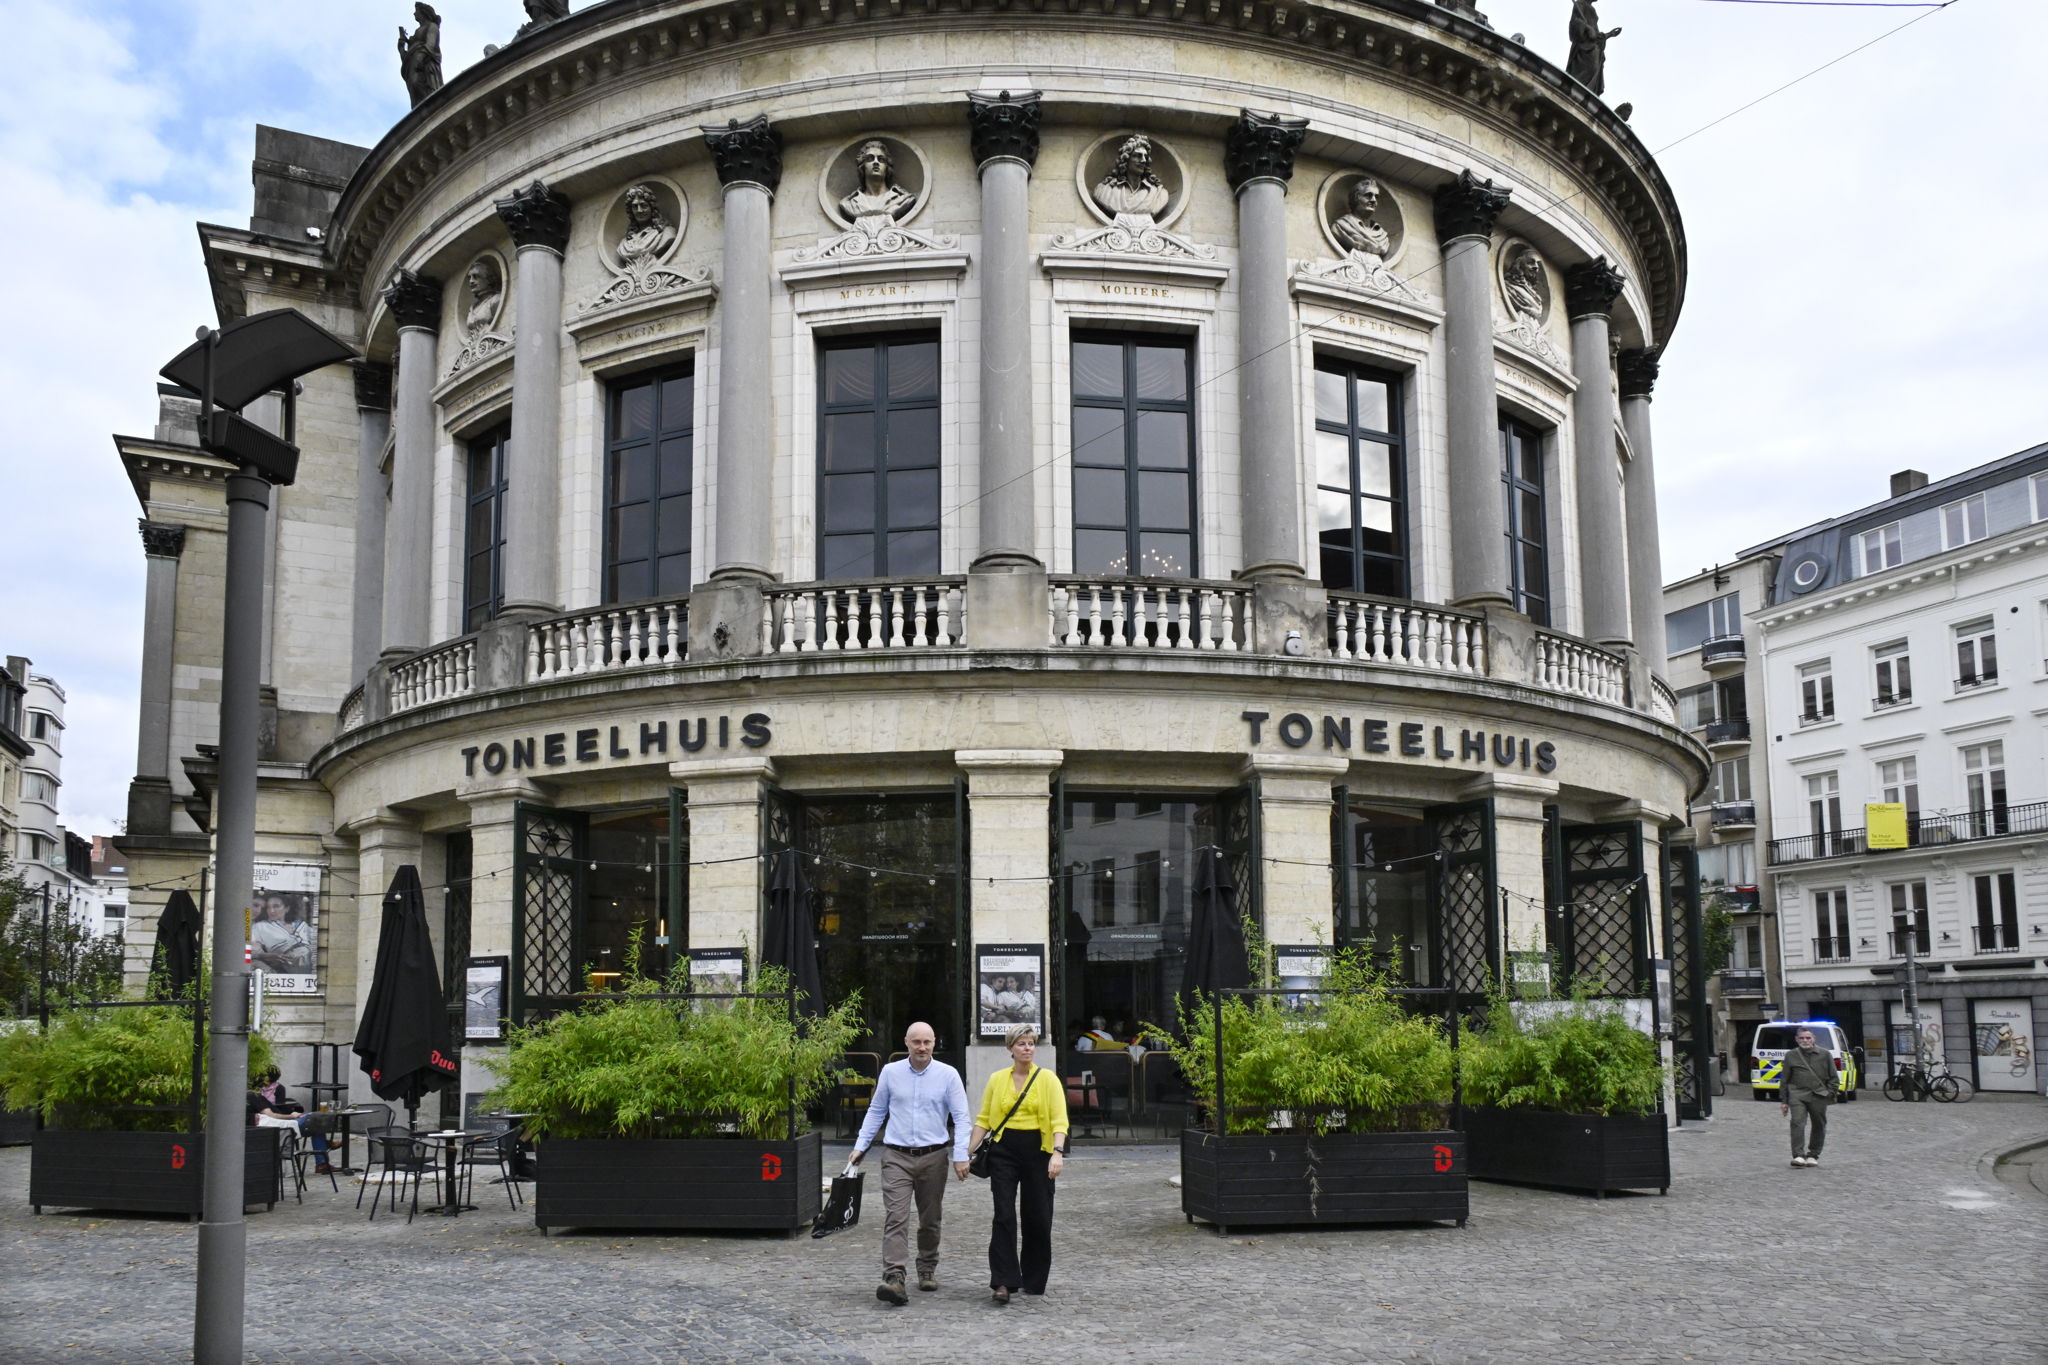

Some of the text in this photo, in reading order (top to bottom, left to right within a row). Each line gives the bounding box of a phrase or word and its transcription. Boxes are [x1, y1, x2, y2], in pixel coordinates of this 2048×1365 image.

[1101, 285, 1174, 298] MOLIERE.
[461, 712, 772, 777] TONEELHUIS
[1242, 711, 1557, 773] TONEELHUIS
